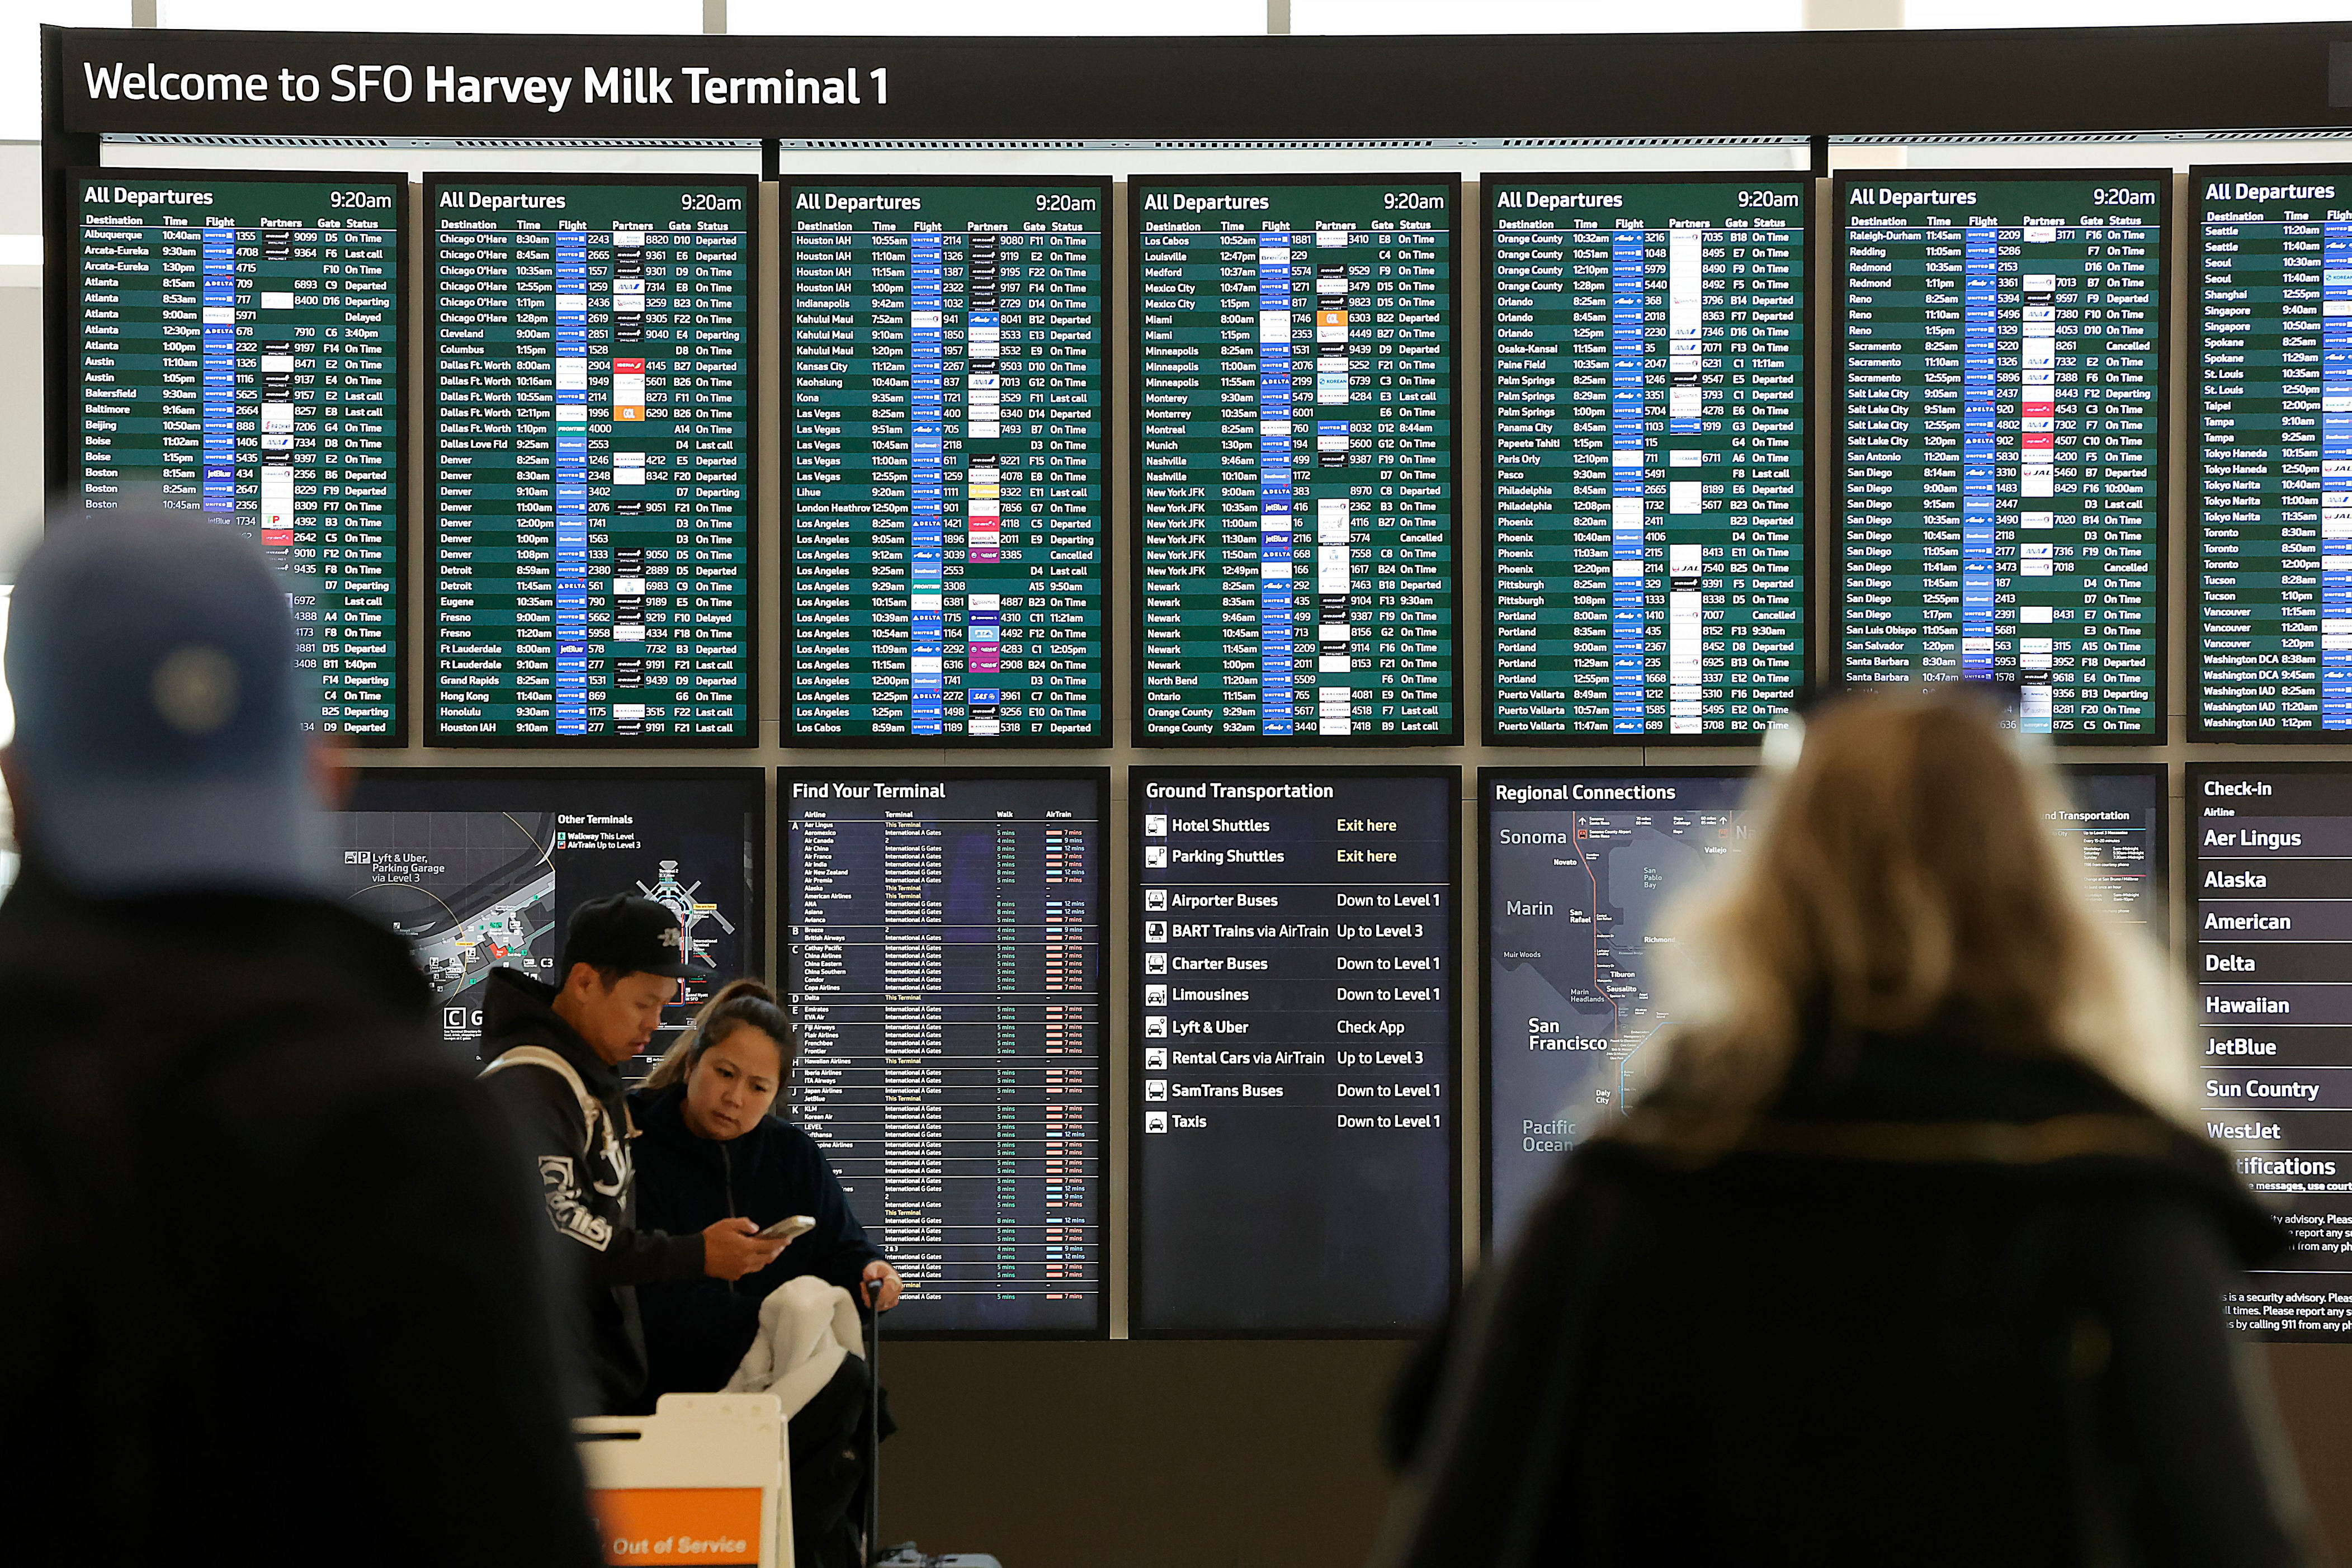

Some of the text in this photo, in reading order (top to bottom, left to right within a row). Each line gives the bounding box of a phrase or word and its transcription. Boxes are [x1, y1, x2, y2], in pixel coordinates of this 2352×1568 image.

[84, 63, 886, 112] Welcome to SFO Harvey Milk Terminal 1
[84, 187, 212, 207] All Departures
[331, 191, 391, 207] 9:20am
[1385, 193, 1443, 209] 9:20am
[1739, 191, 1798, 207] 9:20am
[1850, 188, 1976, 209] All Departures
[2094, 188, 2155, 205] 9:20am
[2205, 183, 2335, 204] All Departures
[440, 192, 565, 212] All Departures
[682, 194, 741, 210] 9:20am
[796, 193, 920, 214] All Departures
[1037, 195, 1095, 211] 9:20am
[1145, 194, 1269, 213] All Departures
[1498, 192, 1622, 212] All Departures
[86, 215, 378, 228] Destination Time Flight Partners Gate Status
[1145, 252, 1187, 261] Louisville
[1220, 252, 1255, 262] 12:47pm
[1291, 251, 1307, 259] 229
[1379, 251, 1391, 259] C4
[1399, 251, 1411, 259] On
[1413, 251, 1434, 259] Time
[84, 262, 382, 274] Arcata-Eureka 1:30pm 4715 F10 On Time
[2205, 289, 2320, 301] Shanghai 12:55pm
[1574, 517, 1607, 526] 8:20am
[1645, 517, 1663, 525] 2411
[1731, 517, 1748, 525] B23
[1753, 516, 1793, 527] Departed
[814, 582, 849, 592] Angeles
[872, 582, 904, 591] 9:29am
[1029, 582, 1044, 591] A15
[1050, 582, 1082, 591] 9:50am
[1846, 625, 2141, 636] San Luis Obispo 11:05am 5681 E3 On Time
[2204, 655, 2316, 665] Washington DCA 8:38am
[441, 692, 552, 702] Hong Kong 11:40am
[794, 783, 946, 797] Find Your Terminal
[1146, 783, 1333, 801] Ground Transportation
[1496, 785, 1675, 803] Regional Connections
[2204, 781, 2271, 795] Check-in
[2059, 811, 2129, 821] Transportation
[2204, 807, 2235, 816] Airline
[558, 815, 633, 824] Other Terminals
[1173, 819, 1396, 832] Hotel Shuttles Exit here
[1500, 830, 1566, 843] Sonoma
[2204, 830, 2301, 849] Aer Lingus
[373, 854, 392, 865] Lyft
[403, 854, 427, 863] Uber,
[373, 864, 445, 875] Parking Garage
[388, 873, 412, 882] Level
[414, 873, 419, 882] 3
[2204, 871, 2266, 887] Alaska
[1508, 901, 1553, 915] Marin
[2205, 913, 2290, 929] American
[541, 958, 552, 967] C3
[2206, 955, 2255, 971] Delta
[2207, 996, 2289, 1013] Hawaiian
[449, 1010, 460, 1025] C
[1529, 1018, 1559, 1033] San
[1530, 1036, 1607, 1050] Francisco
[2205, 1038, 2276, 1055] JetBlue
[2207, 1080, 2319, 1101] Sun Country
[1172, 1115, 1207, 1127] Taxis
[2207, 1122, 2280, 1139] WestJet
[2285, 1292, 2326, 1304] advisory.
[2236, 1319, 2340, 1331] by calling 911 from any
[614, 1537, 746, 1554] Out of Service
